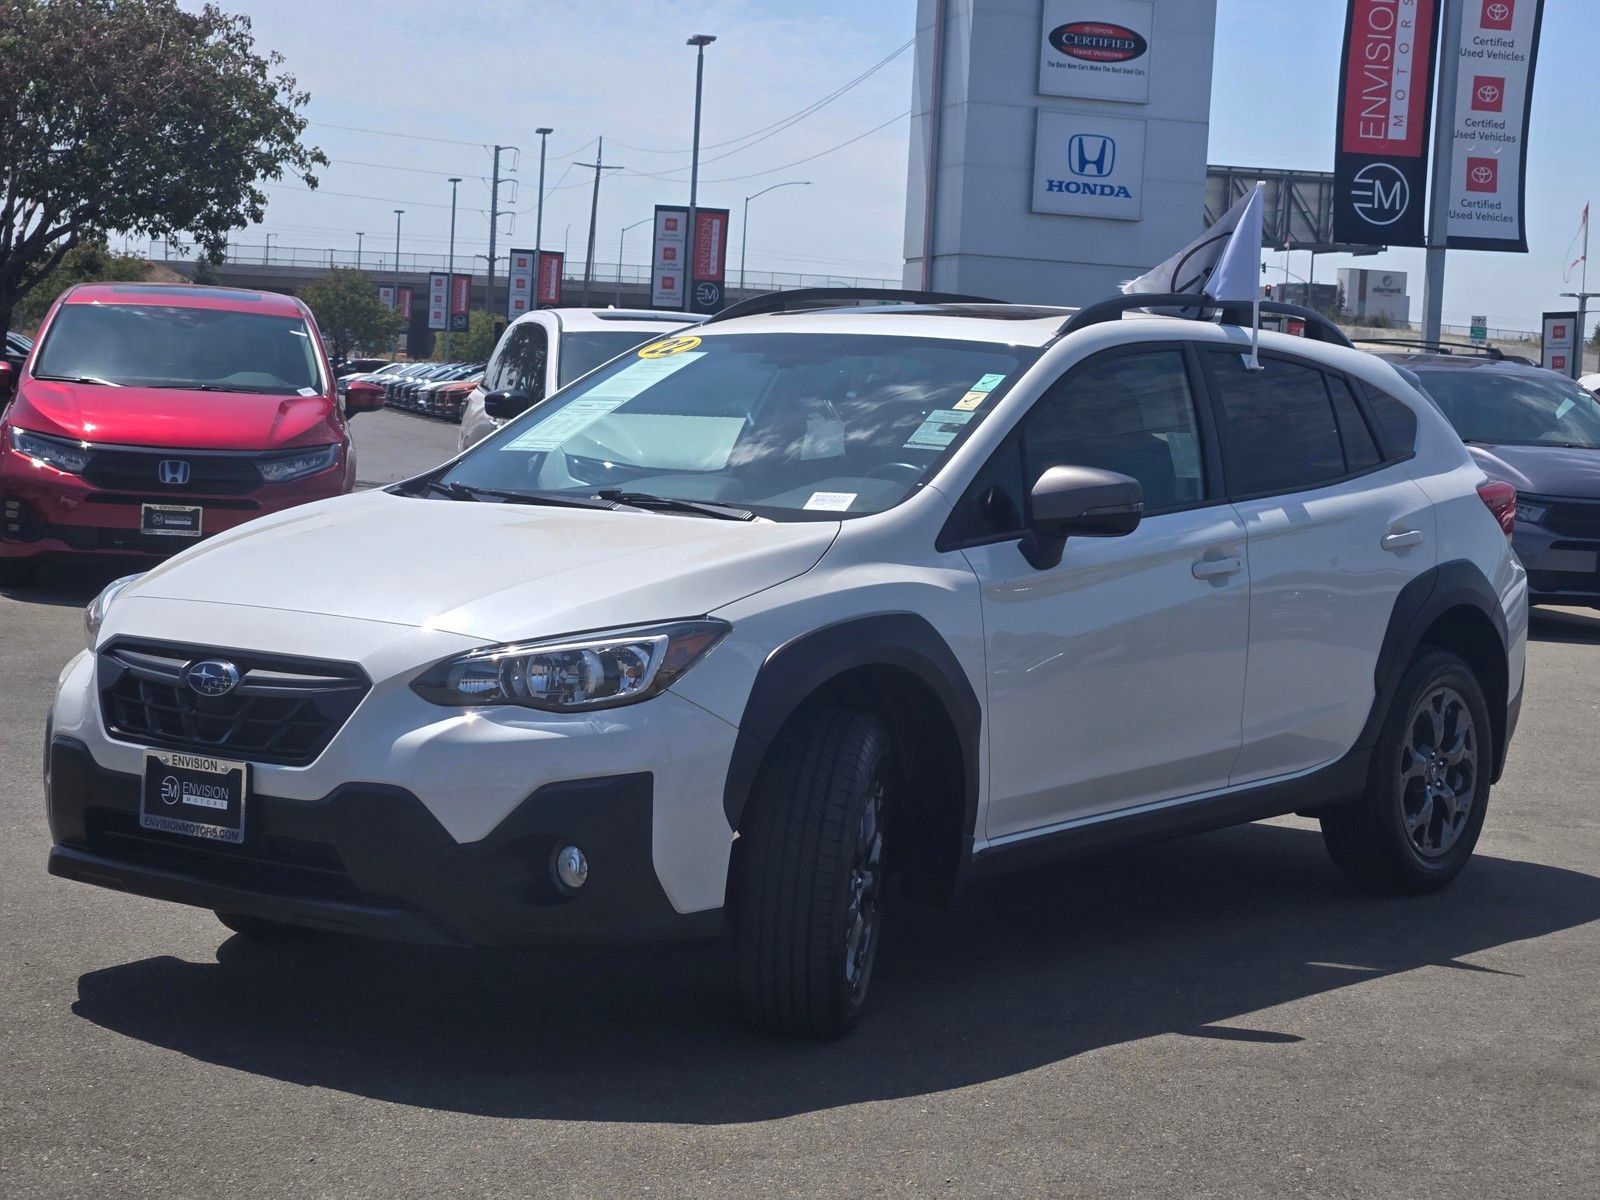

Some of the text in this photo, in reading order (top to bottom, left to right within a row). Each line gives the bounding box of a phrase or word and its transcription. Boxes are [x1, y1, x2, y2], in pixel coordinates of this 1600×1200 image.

[1092, 27, 1114, 35] TOYOTA
[1062, 33, 1135, 49] CERTIFIED
[1473, 36, 1515, 48] Certified
[1073, 48, 1124, 58] Used Vehicles
[1460, 48, 1525, 61] Used Vehicles
[1078, 63, 1089, 71] Cars
[1392, 0, 1414, 127] MOTORS
[1465, 118, 1505, 129] Certified
[1478, 132, 1517, 143] Vehicles
[1046, 179, 1132, 199] HONDA
[1461, 199, 1502, 210] Certified
[1449, 210, 1514, 223] Used Vehicles
[172, 754, 218, 771] ENVISION
[182, 781, 228, 799] ENVISION
[186, 797, 225, 807] MOTORS
[144, 817, 240, 840] ENVISIONMOTORS.COM
